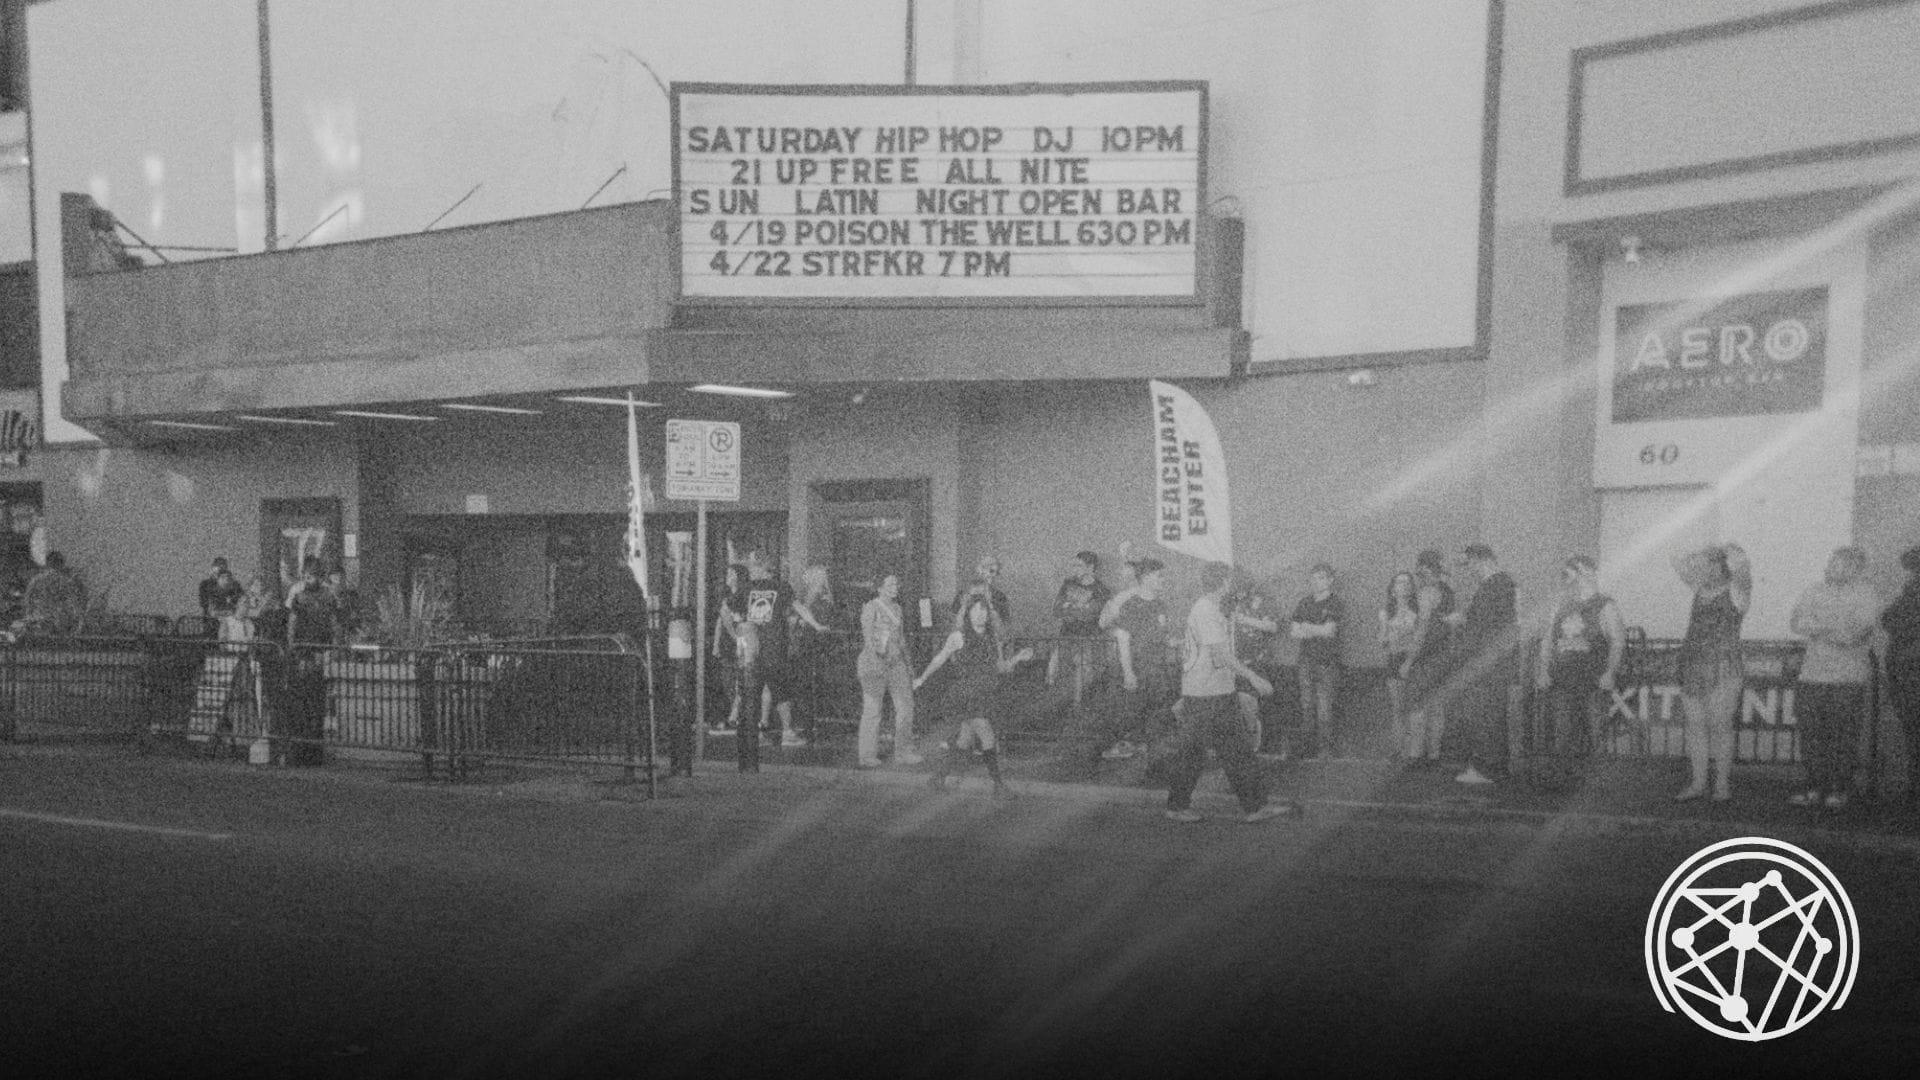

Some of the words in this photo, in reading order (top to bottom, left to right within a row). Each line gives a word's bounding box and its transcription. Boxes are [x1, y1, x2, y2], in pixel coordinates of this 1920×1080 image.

[688, 126, 860, 154] SATURDAY
[876, 127, 928, 153] HIP
[940, 127, 1002, 153] HOP
[1035, 128, 1072, 152] DJ
[731, 159, 761, 185] 21
[776, 158, 817, 185] UP
[830, 158, 918, 184] FREE
[945, 158, 1000, 184] ALL
[1021, 158, 1088, 184] NITE
[690, 189, 758, 215] SUN
[796, 189, 878, 215] LATIN
[917, 189, 1009, 215] NIGHT
[1019, 190, 1101, 215] OPEN
[1118, 189, 1180, 214] BAR
[710, 220, 785, 246] 4/19
[796, 220, 910, 246] POISON
[923, 219, 978, 246] THE
[986, 220, 1069, 246] WELL
[1078, 220, 1136, 246] 630
[1144, 220, 1190, 245] PM
[710, 250, 791, 277] 4/22
[803, 250, 924, 277] STRFKR
[938, 251, 955, 277] 7
[964, 251, 1011, 277] PM
[1630, 318, 1810, 371] AERO
[1158, 394, 1182, 542] BEACHAM
[1639, 444, 1680, 465] 60
[1183, 439, 1208, 536] ENTER
[1607, 685, 1682, 722] XIT
